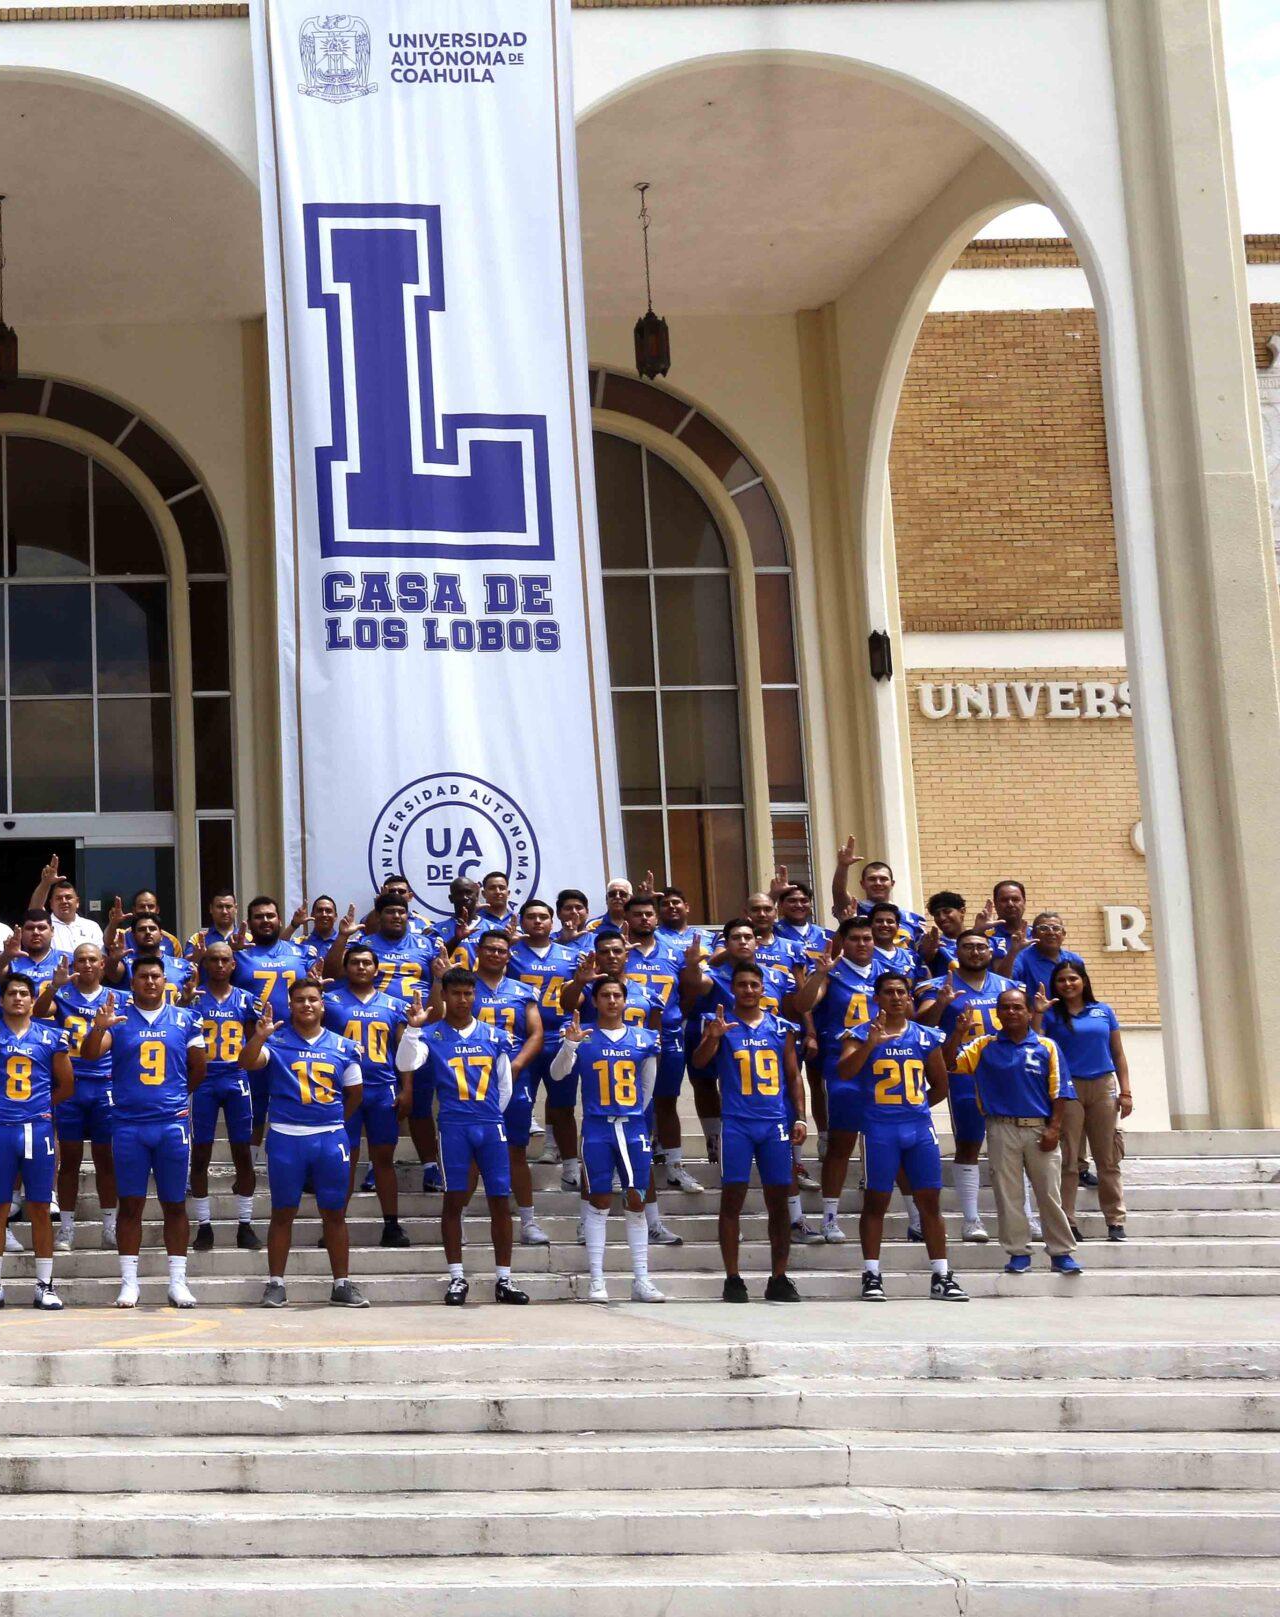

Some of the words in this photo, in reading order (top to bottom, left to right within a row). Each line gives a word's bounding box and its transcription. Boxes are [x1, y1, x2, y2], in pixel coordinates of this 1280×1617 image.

[388, 32, 527, 48] UNIVERSIDAD
[392, 47, 506, 66] AUTÓNOMA
[509, 53, 524, 62] DE
[391, 68, 495, 83] COAHUILA
[303, 203, 555, 561] L
[322, 571, 466, 614] CASA
[483, 573, 553, 615] DE
[325, 617, 408, 652] LOS
[424, 617, 561, 652] LOBOS
[382, 784, 460, 879] UNIVERSIDAD
[469, 789, 528, 882] AUTÓNOMA
[426, 827, 482, 857] UA
[427, 864, 453, 880] DE
[905, 912, 915, 923] L
[291, 947, 301, 955] L
[417, 938, 426, 948] L
[786, 943, 794, 956] L
[562, 949, 571, 960] L
[668, 948, 677, 960] L
[174, 959, 182, 968] L
[378, 963, 421, 996] 72
[768, 970, 779, 983] L
[255, 972, 295, 1009] 71
[515, 985, 524, 996] L
[522, 976, 563, 1015] 74
[239, 994, 247, 1008] L
[386, 997, 396, 1010] L
[176, 1013, 185, 1027] L
[479, 1008, 514, 1032] 41
[777, 1018, 787, 1034] L
[42, 1031, 51, 1044] L
[345, 1021, 388, 1062] 40
[489, 1027, 498, 1042] L
[636, 1034, 646, 1047] L
[920, 1031, 930, 1045] L
[337, 1038, 346, 1052] L
[675, 1039, 682, 1051] L
[140, 1041, 165, 1084] 9
[7, 1057, 31, 1099] 8
[450, 1057, 492, 1099] 17
[735, 1050, 778, 1094] 19
[238, 1080, 251, 1097] L
[292, 1062, 333, 1103] 15
[594, 1061, 636, 1105] 18
[874, 1060, 924, 1104] 20
[390, 1085, 395, 1100] L
[179, 1126, 189, 1144] L
[497, 1124, 507, 1141] L
[778, 1124, 789, 1141] L
[929, 1127, 939, 1145] L
[45, 1137, 54, 1155] L
[641, 1135, 650, 1152] L
[340, 1144, 349, 1161] L
